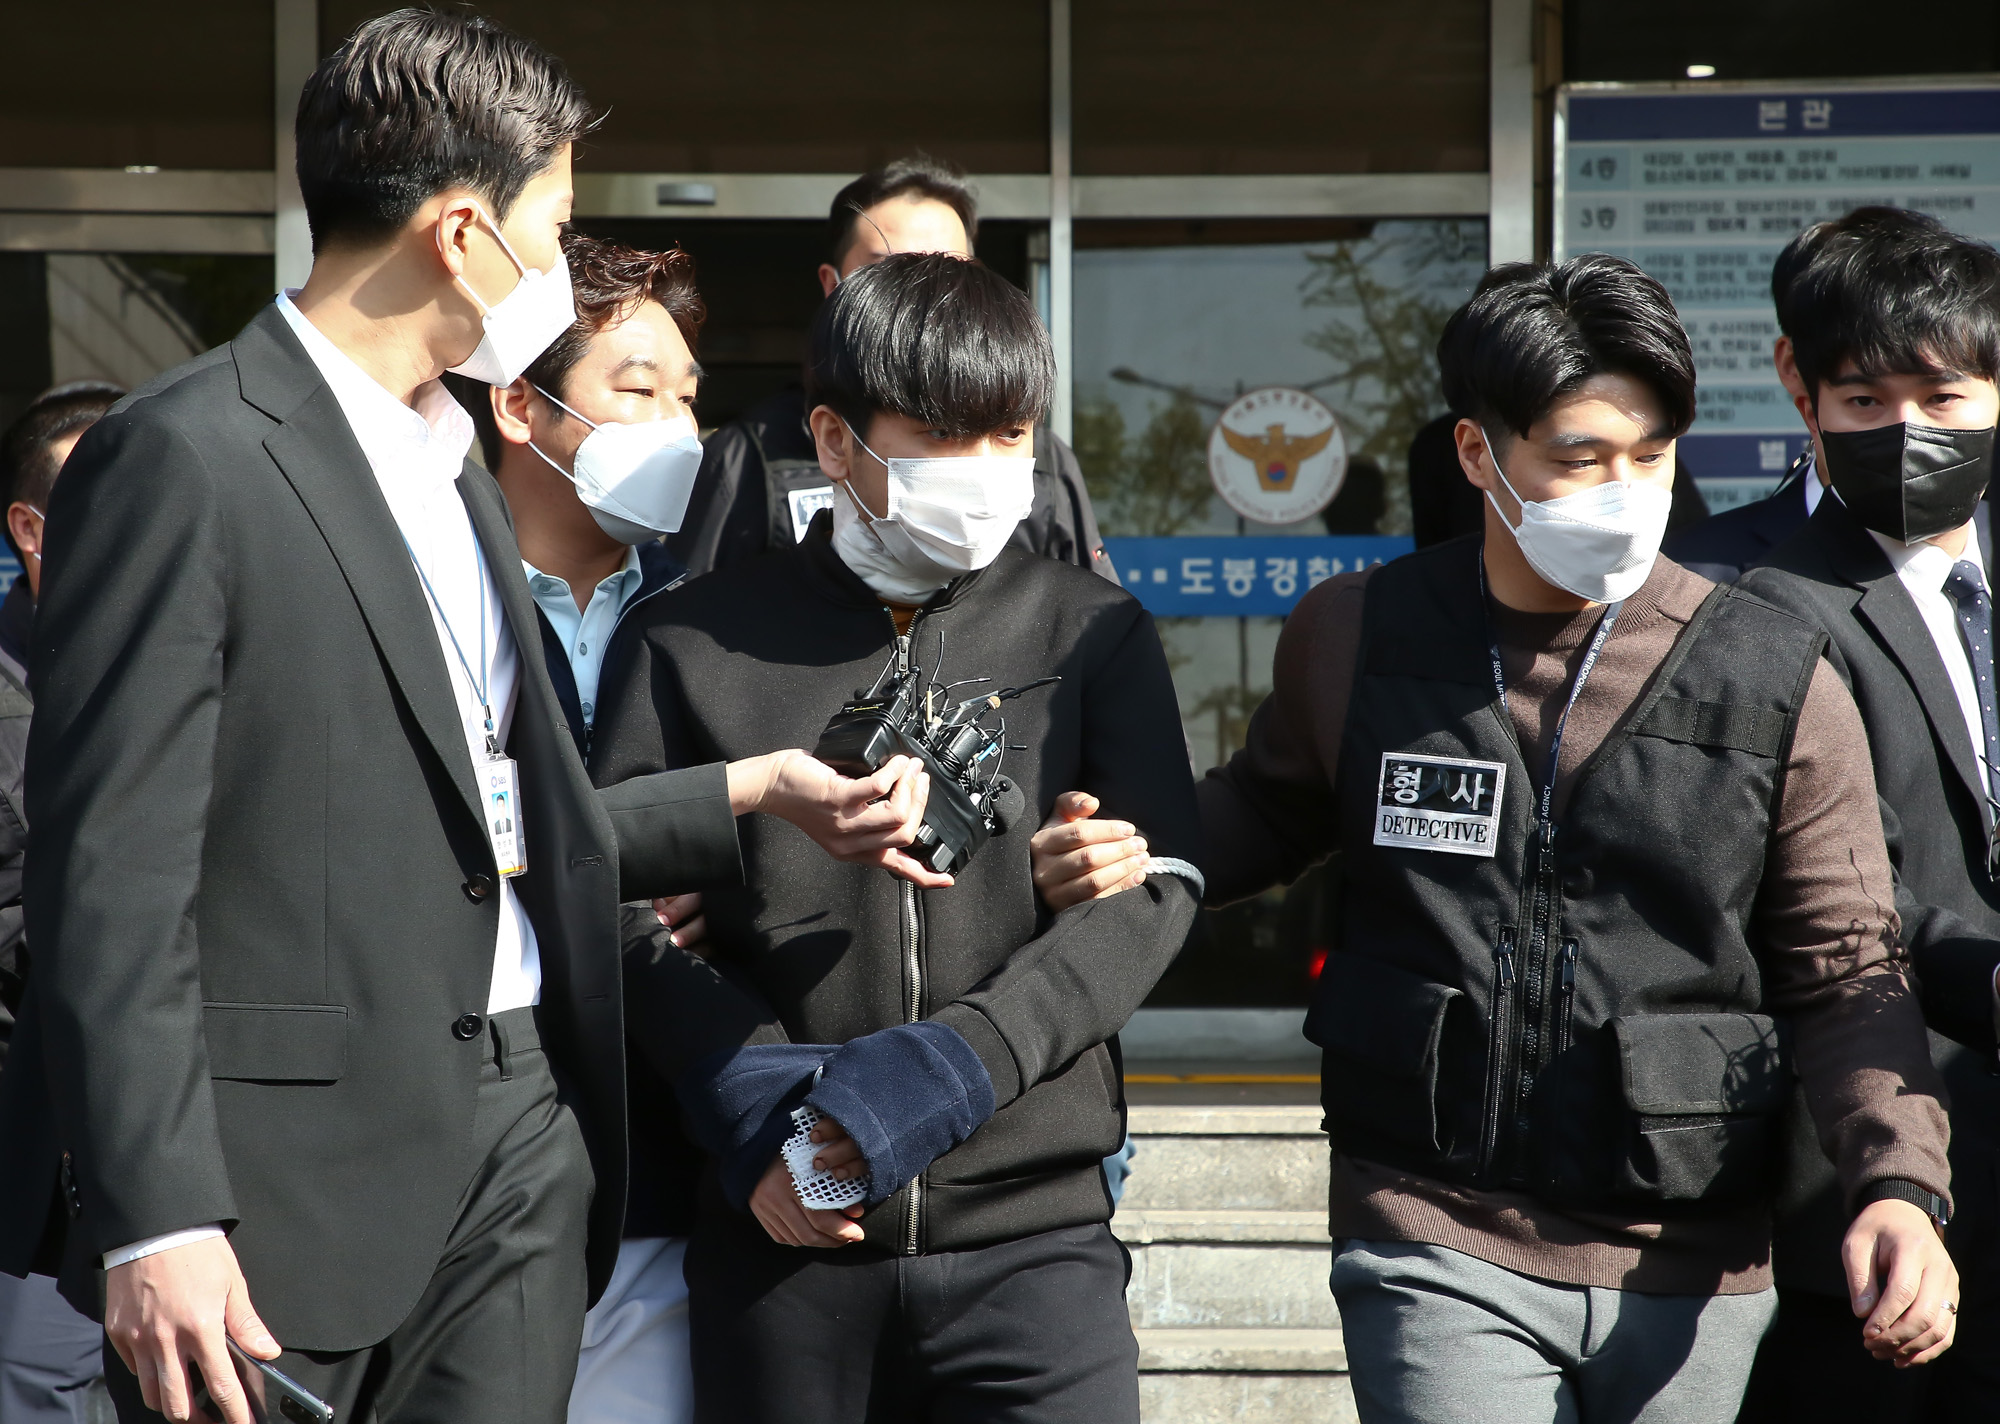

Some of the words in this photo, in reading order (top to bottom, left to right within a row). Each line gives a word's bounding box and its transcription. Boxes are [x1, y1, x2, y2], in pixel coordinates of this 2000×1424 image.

[1180, 556, 1383, 597] 도봉경찰
[1592, 630, 1607, 651] SEOUL
[1493, 660, 1503, 682] SEOUL
[1393, 765, 1486, 811] 형사
[1541, 784, 1552, 818] AGENCY
[1382, 814, 1488, 843] DETECTIVE
